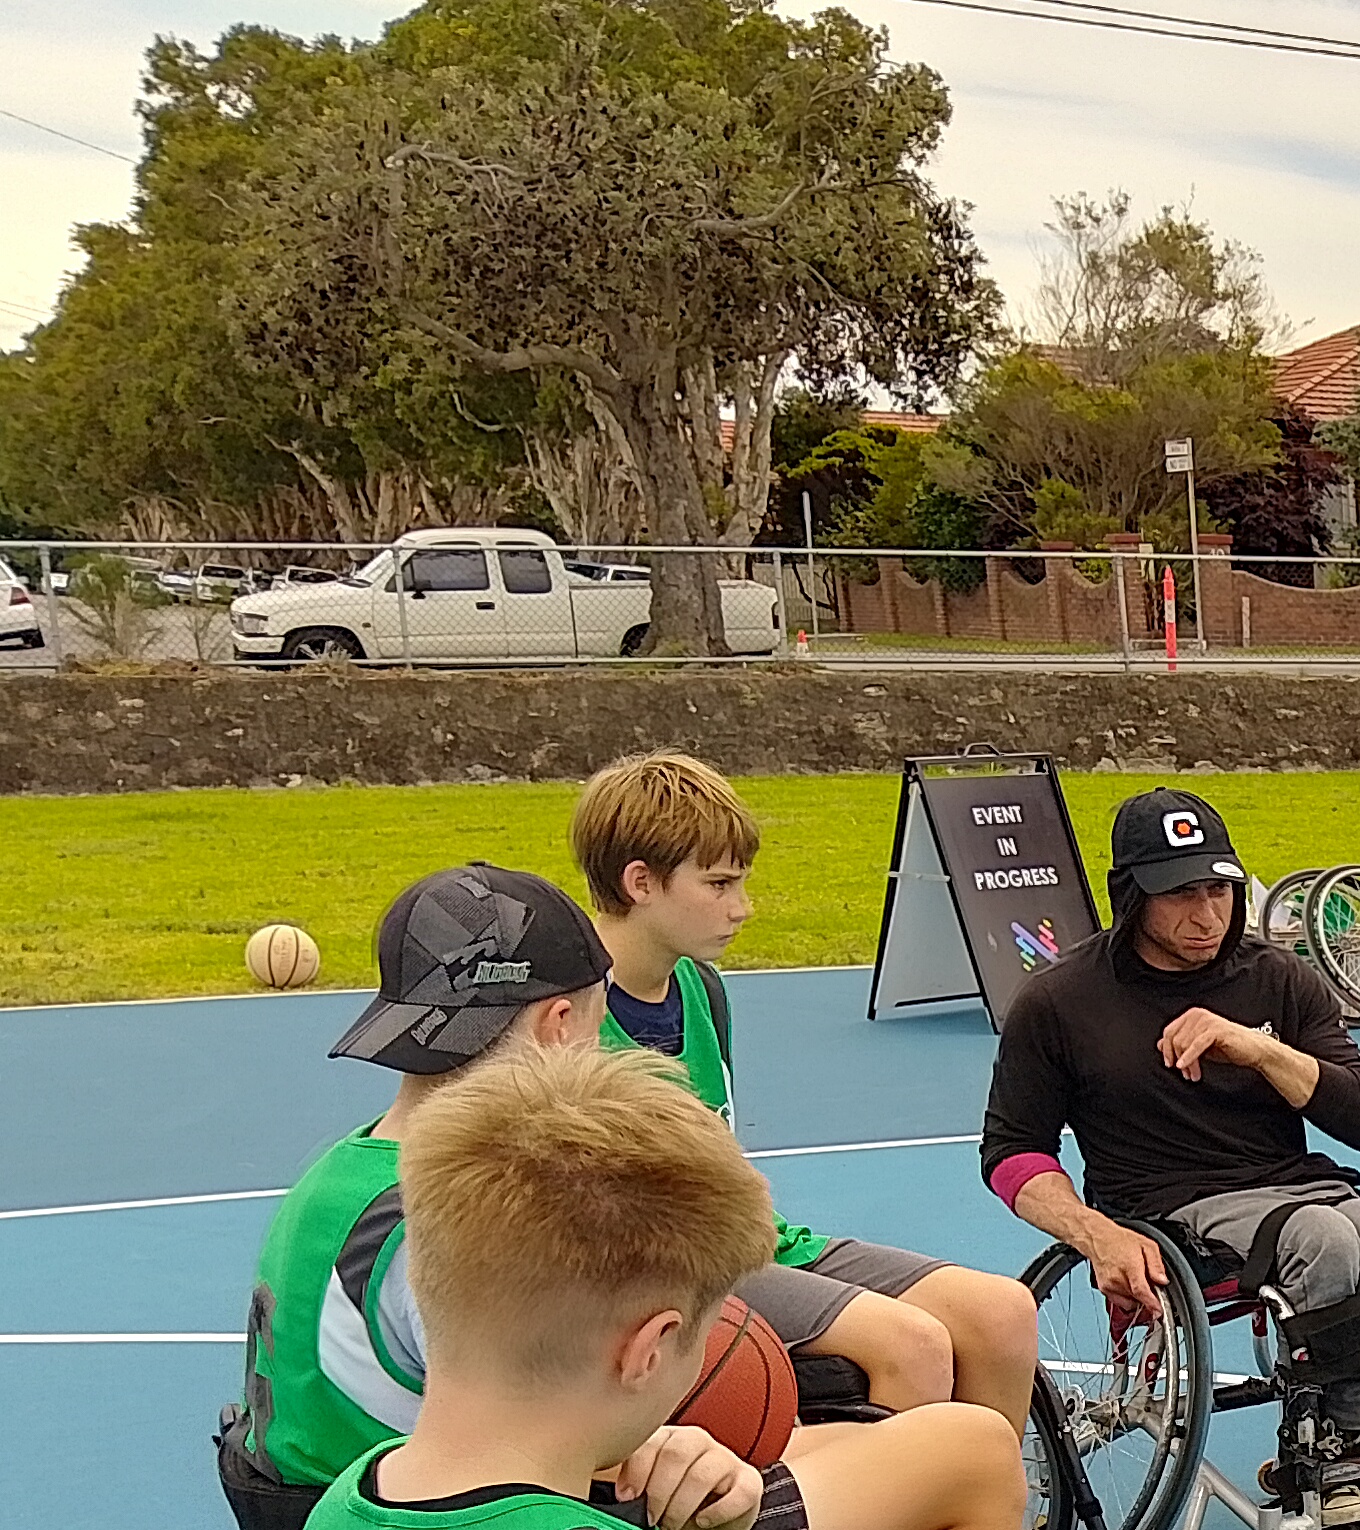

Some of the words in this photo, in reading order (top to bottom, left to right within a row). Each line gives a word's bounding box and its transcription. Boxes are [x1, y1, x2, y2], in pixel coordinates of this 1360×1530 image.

[972, 805, 1023, 825] EVENT
[996, 837, 1018, 856] IN
[974, 867, 1059, 890] PROGRESS
